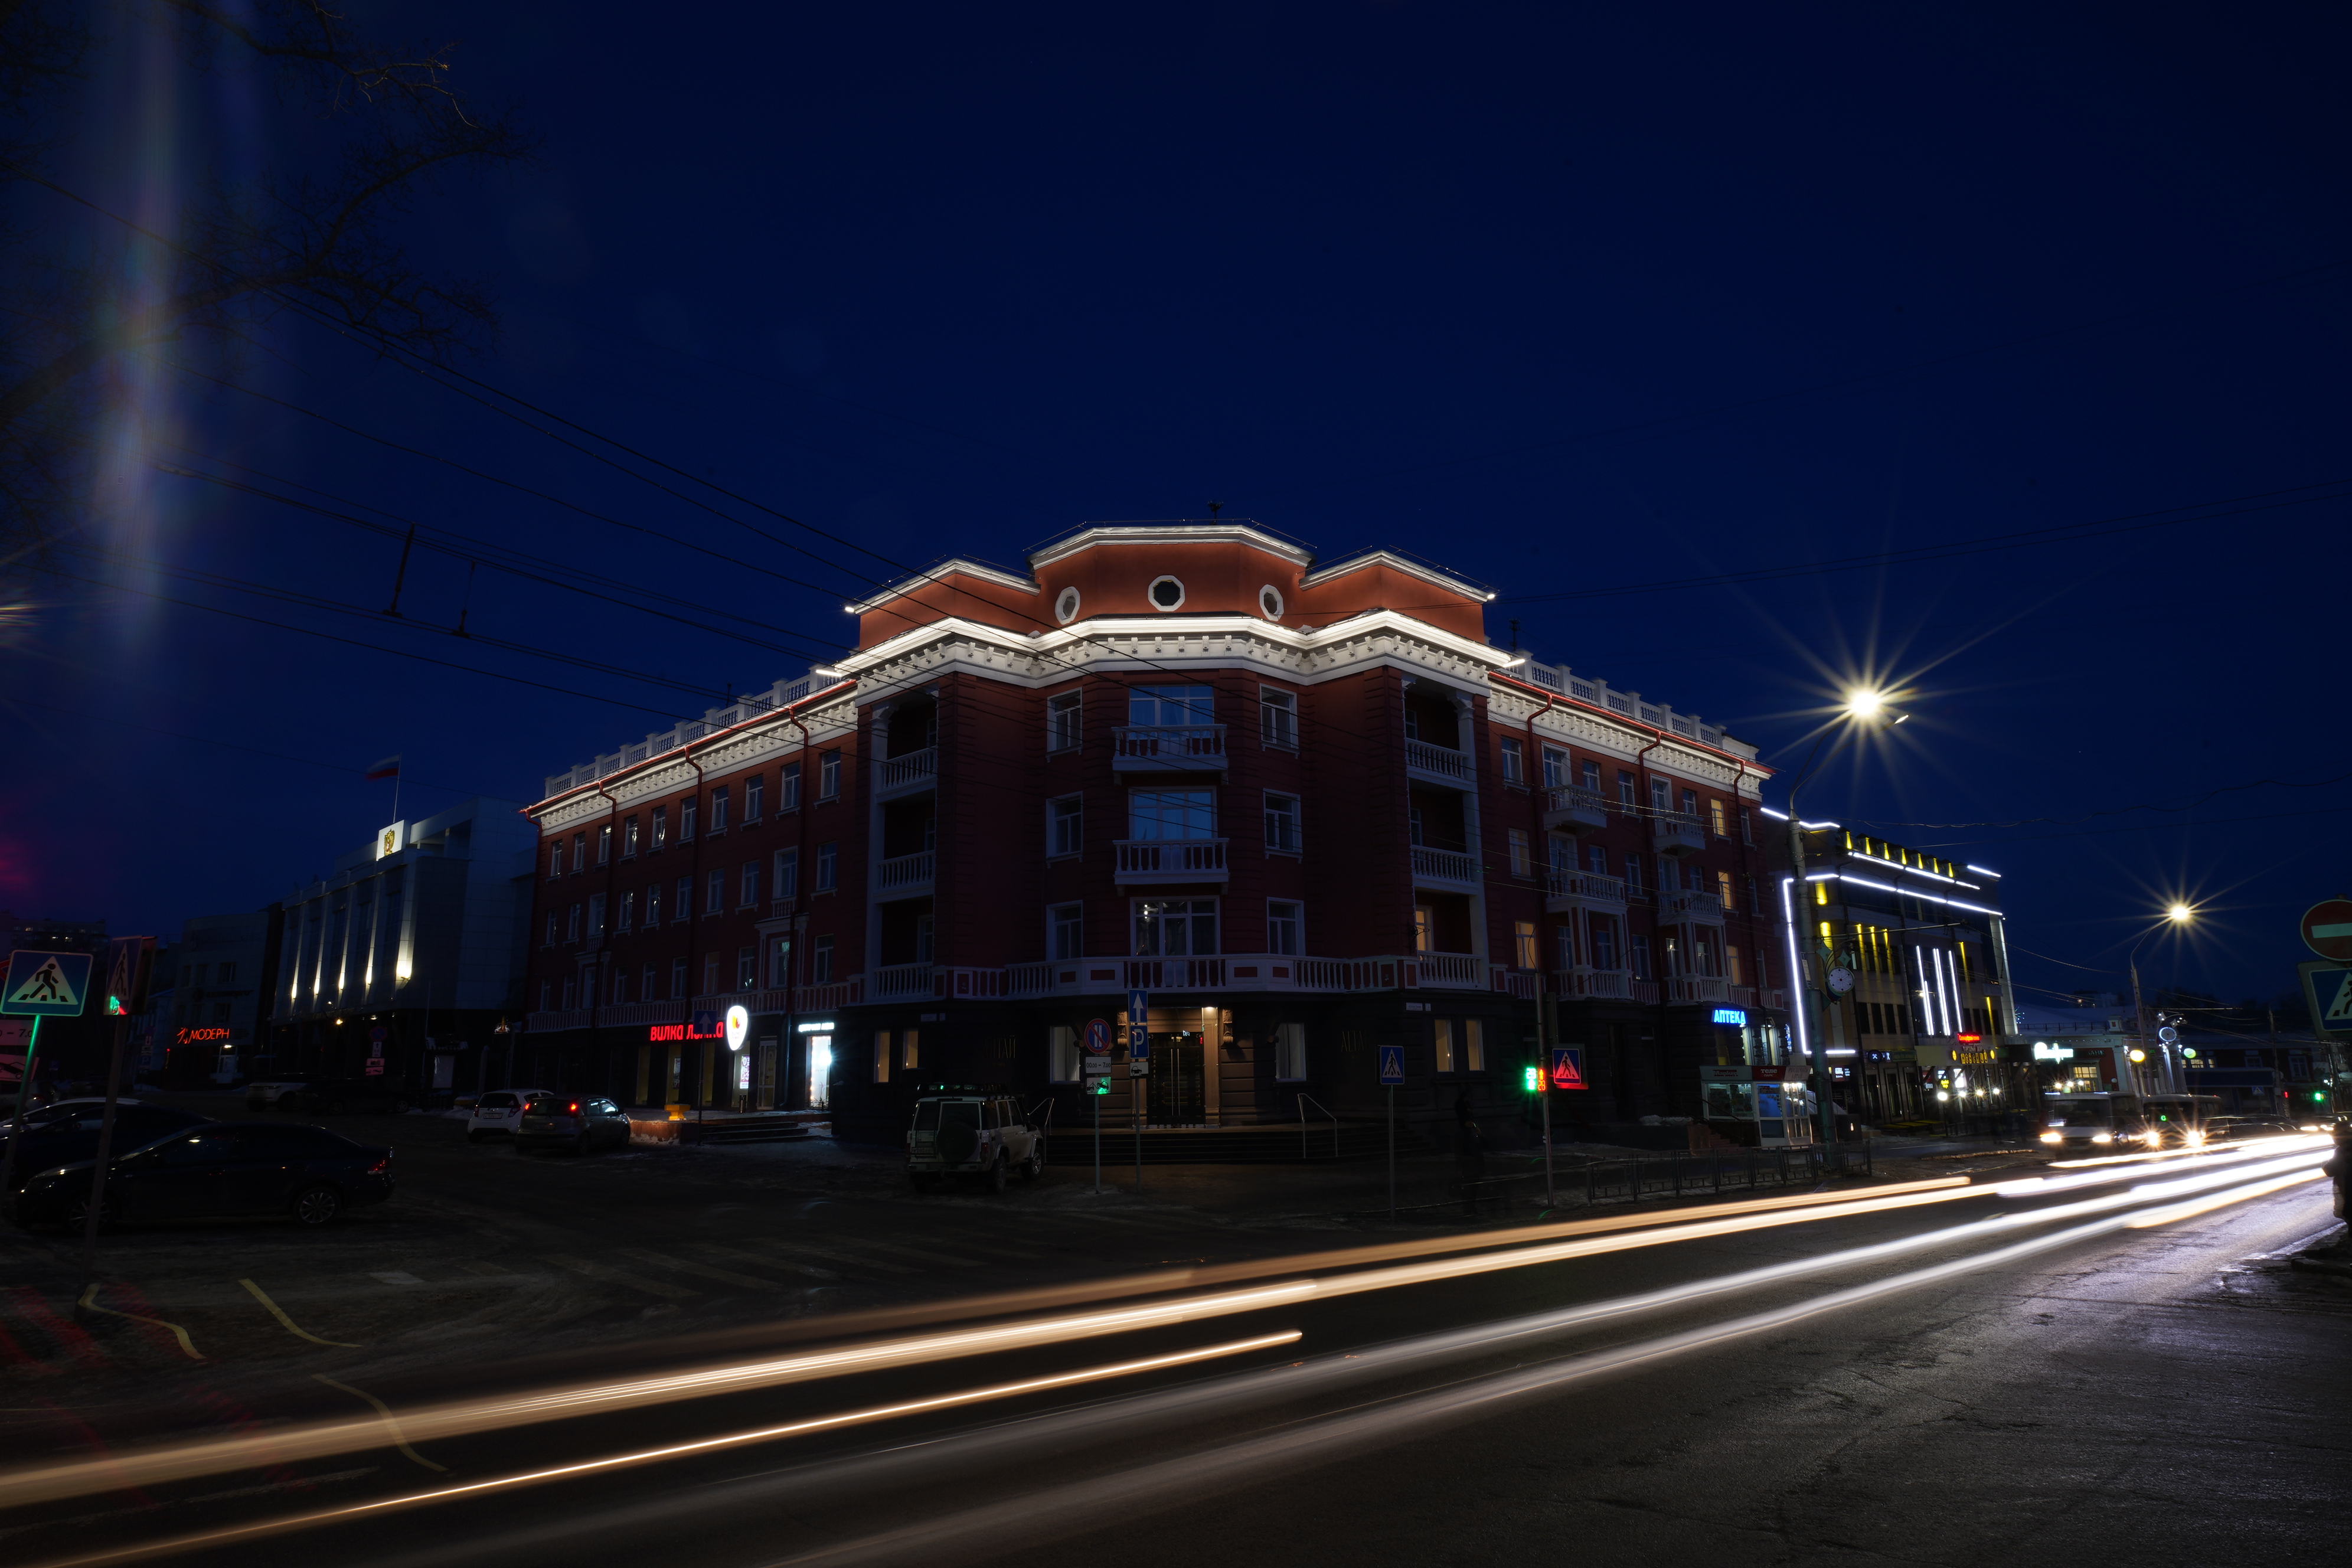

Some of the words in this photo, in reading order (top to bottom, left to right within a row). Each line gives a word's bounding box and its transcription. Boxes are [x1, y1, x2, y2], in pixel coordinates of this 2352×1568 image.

[1714, 1009, 1746, 1024] АПТЕКА
[982, 1035, 1016, 1059] АЛТАЙ
[1341, 1030, 1368, 1052] ALTAI
[1961, 1050, 1988, 1064] НЕВСКИЙ
[1538, 1080, 1546, 1090] 28
